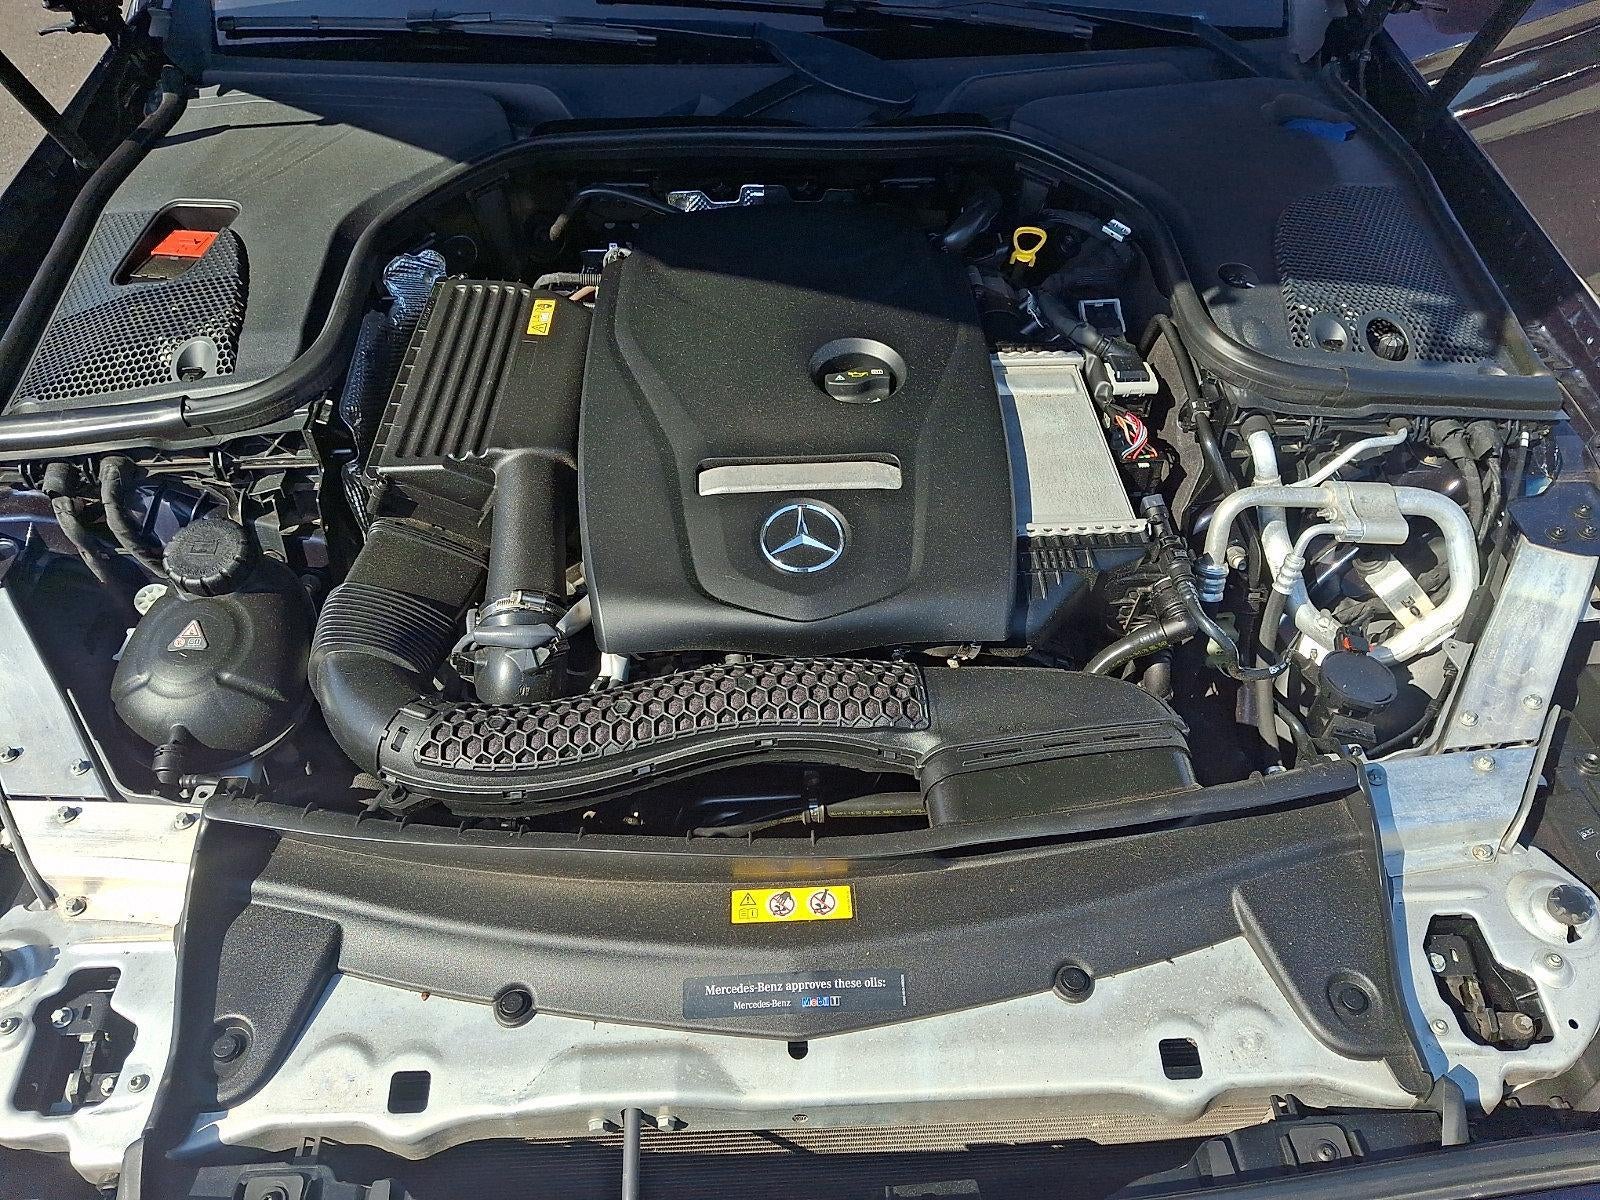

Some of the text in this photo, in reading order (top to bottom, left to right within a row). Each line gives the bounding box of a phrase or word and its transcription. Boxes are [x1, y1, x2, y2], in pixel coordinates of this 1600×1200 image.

[704, 977, 887, 996] Mercedes-Benz approves these oils:
[733, 999, 792, 1010] Mercedes-Benz
[801, 996, 830, 1007] Mobil
